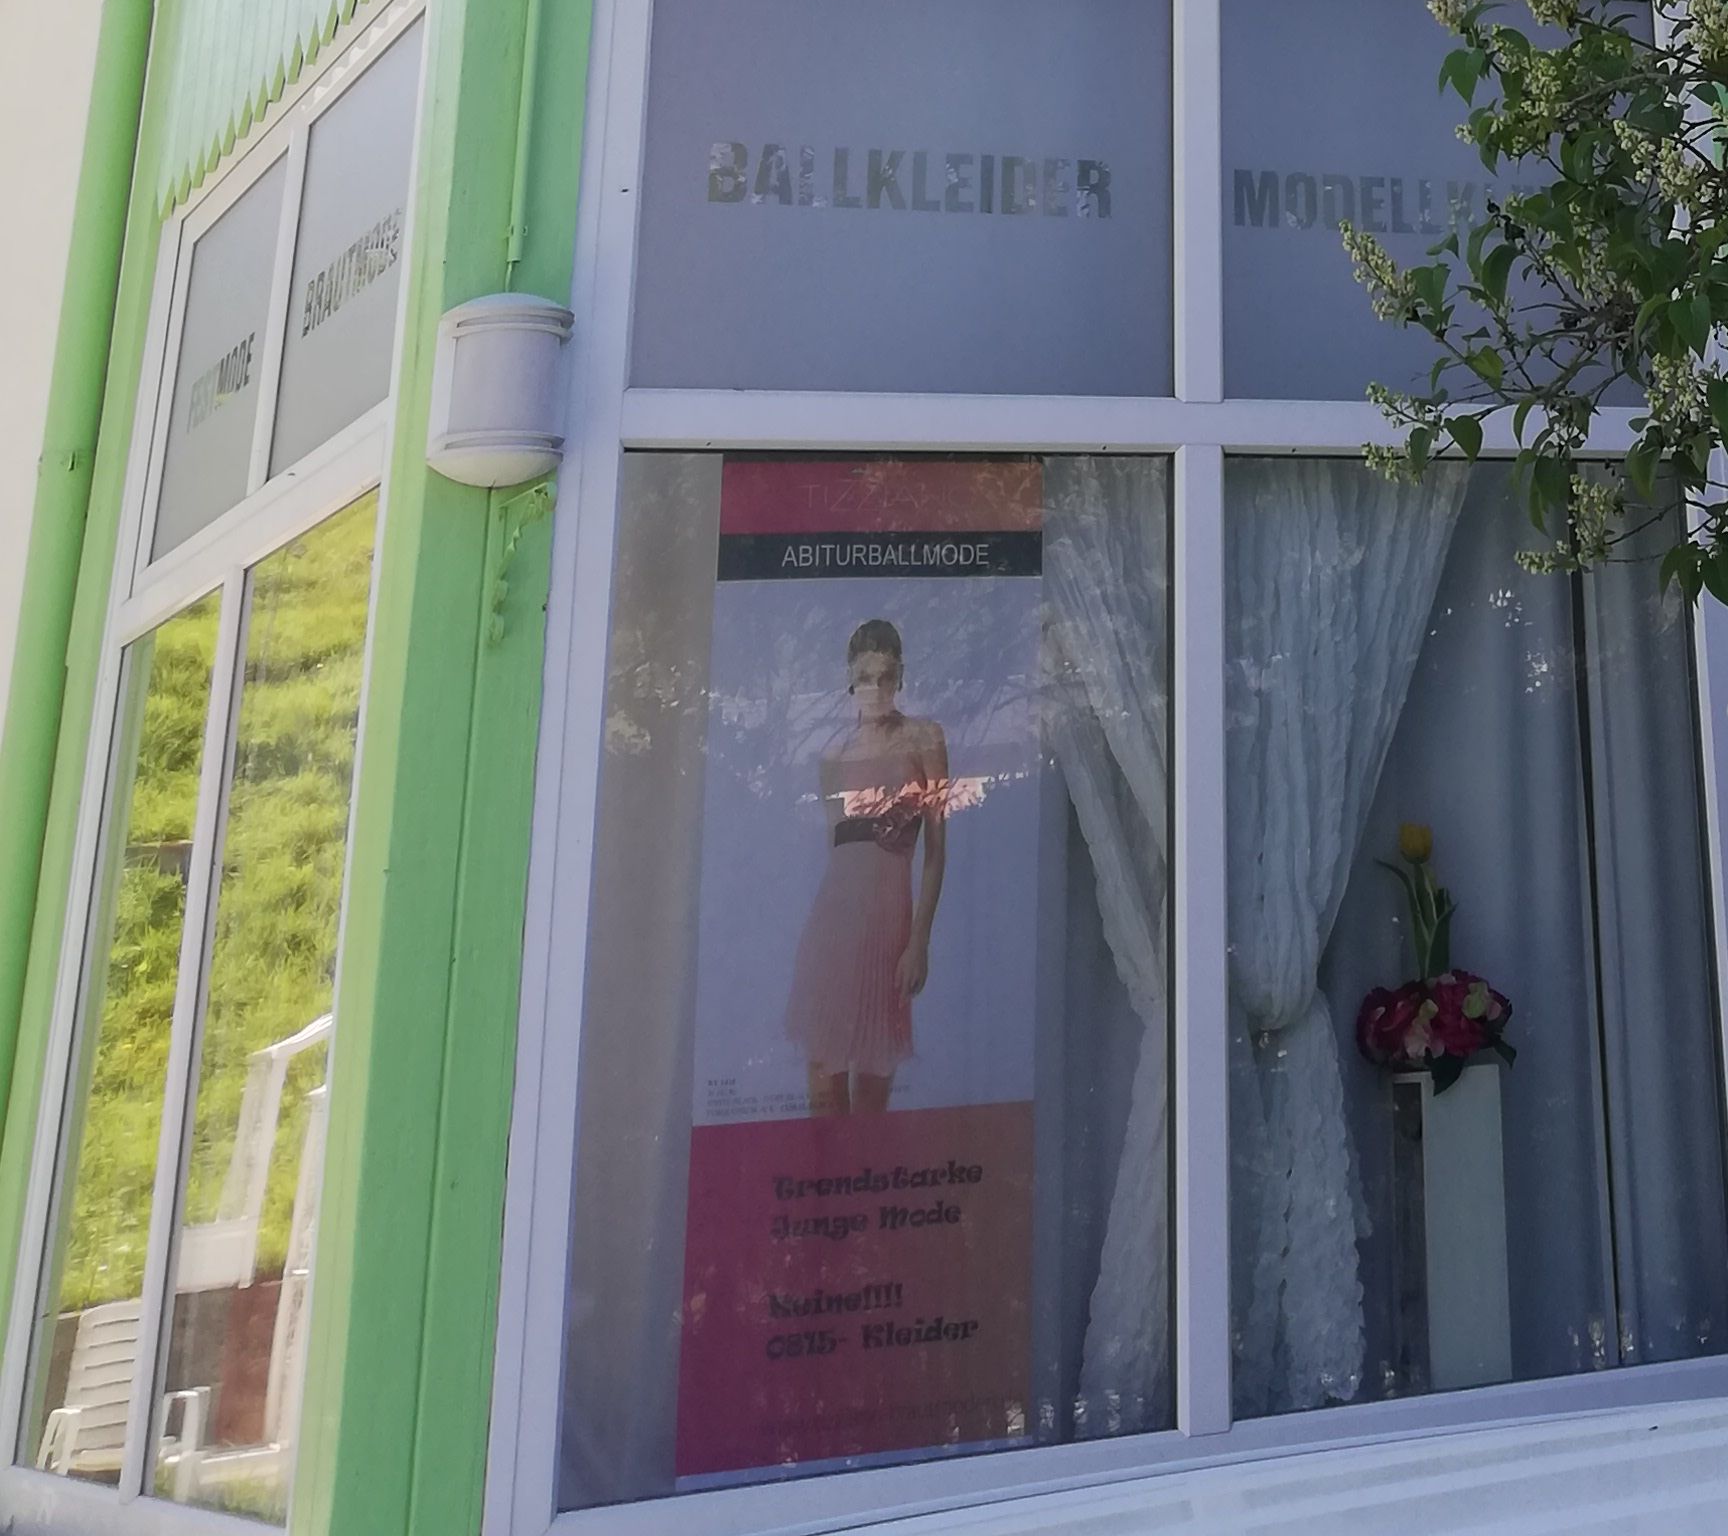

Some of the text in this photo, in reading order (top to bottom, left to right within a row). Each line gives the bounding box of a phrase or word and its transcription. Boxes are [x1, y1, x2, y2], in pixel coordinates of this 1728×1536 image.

[708, 140, 1112, 218] BALLKLEIDER
[781, 543, 990, 568] ABITURBALLMODE
[773, 1161, 983, 1201] Trendstarke
[769, 1200, 962, 1241] Junge Mode
[861, 1316, 979, 1349] Kleider
